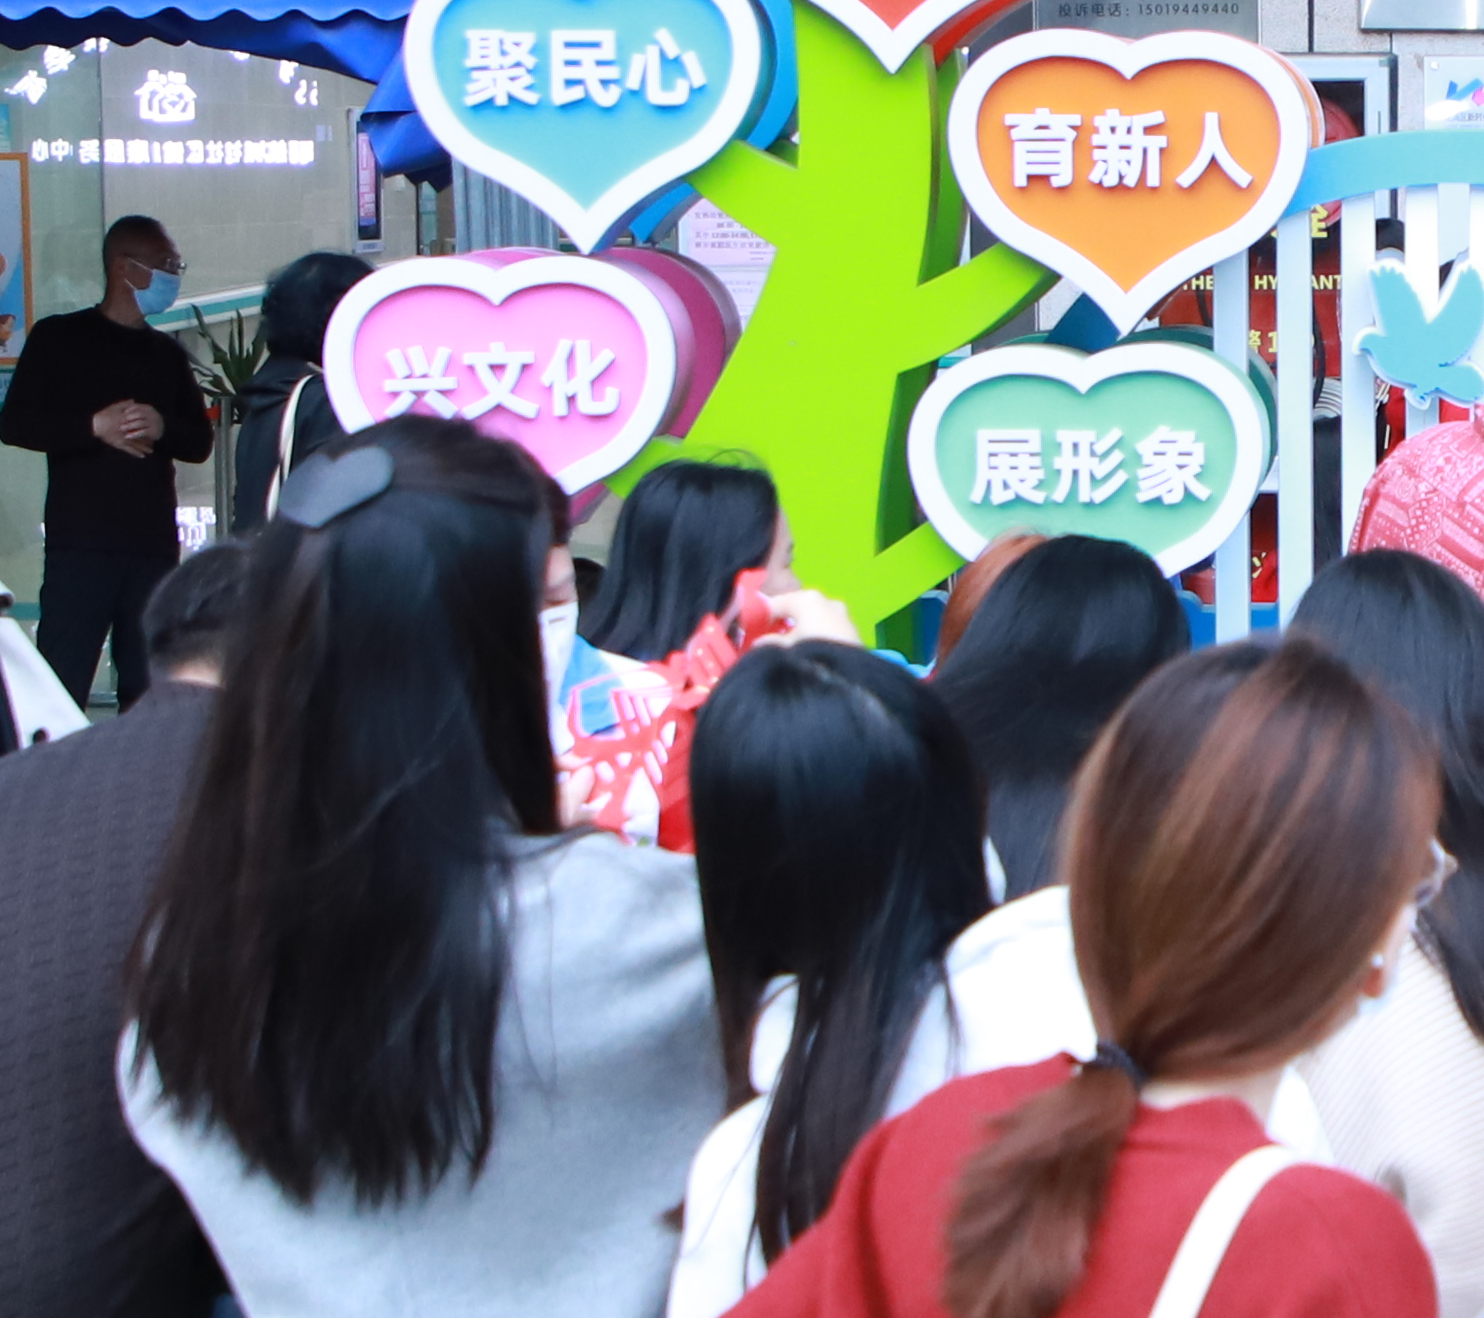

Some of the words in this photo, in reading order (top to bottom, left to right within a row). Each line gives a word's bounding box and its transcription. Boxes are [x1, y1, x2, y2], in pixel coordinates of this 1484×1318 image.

[463, 27, 708, 111] 聚民心
[1002, 107, 1253, 189] 育新人
[1254, 275, 1343, 291] HYANT
[384, 338, 621, 420] 兴文化
[968, 425, 1214, 507] 展形象
